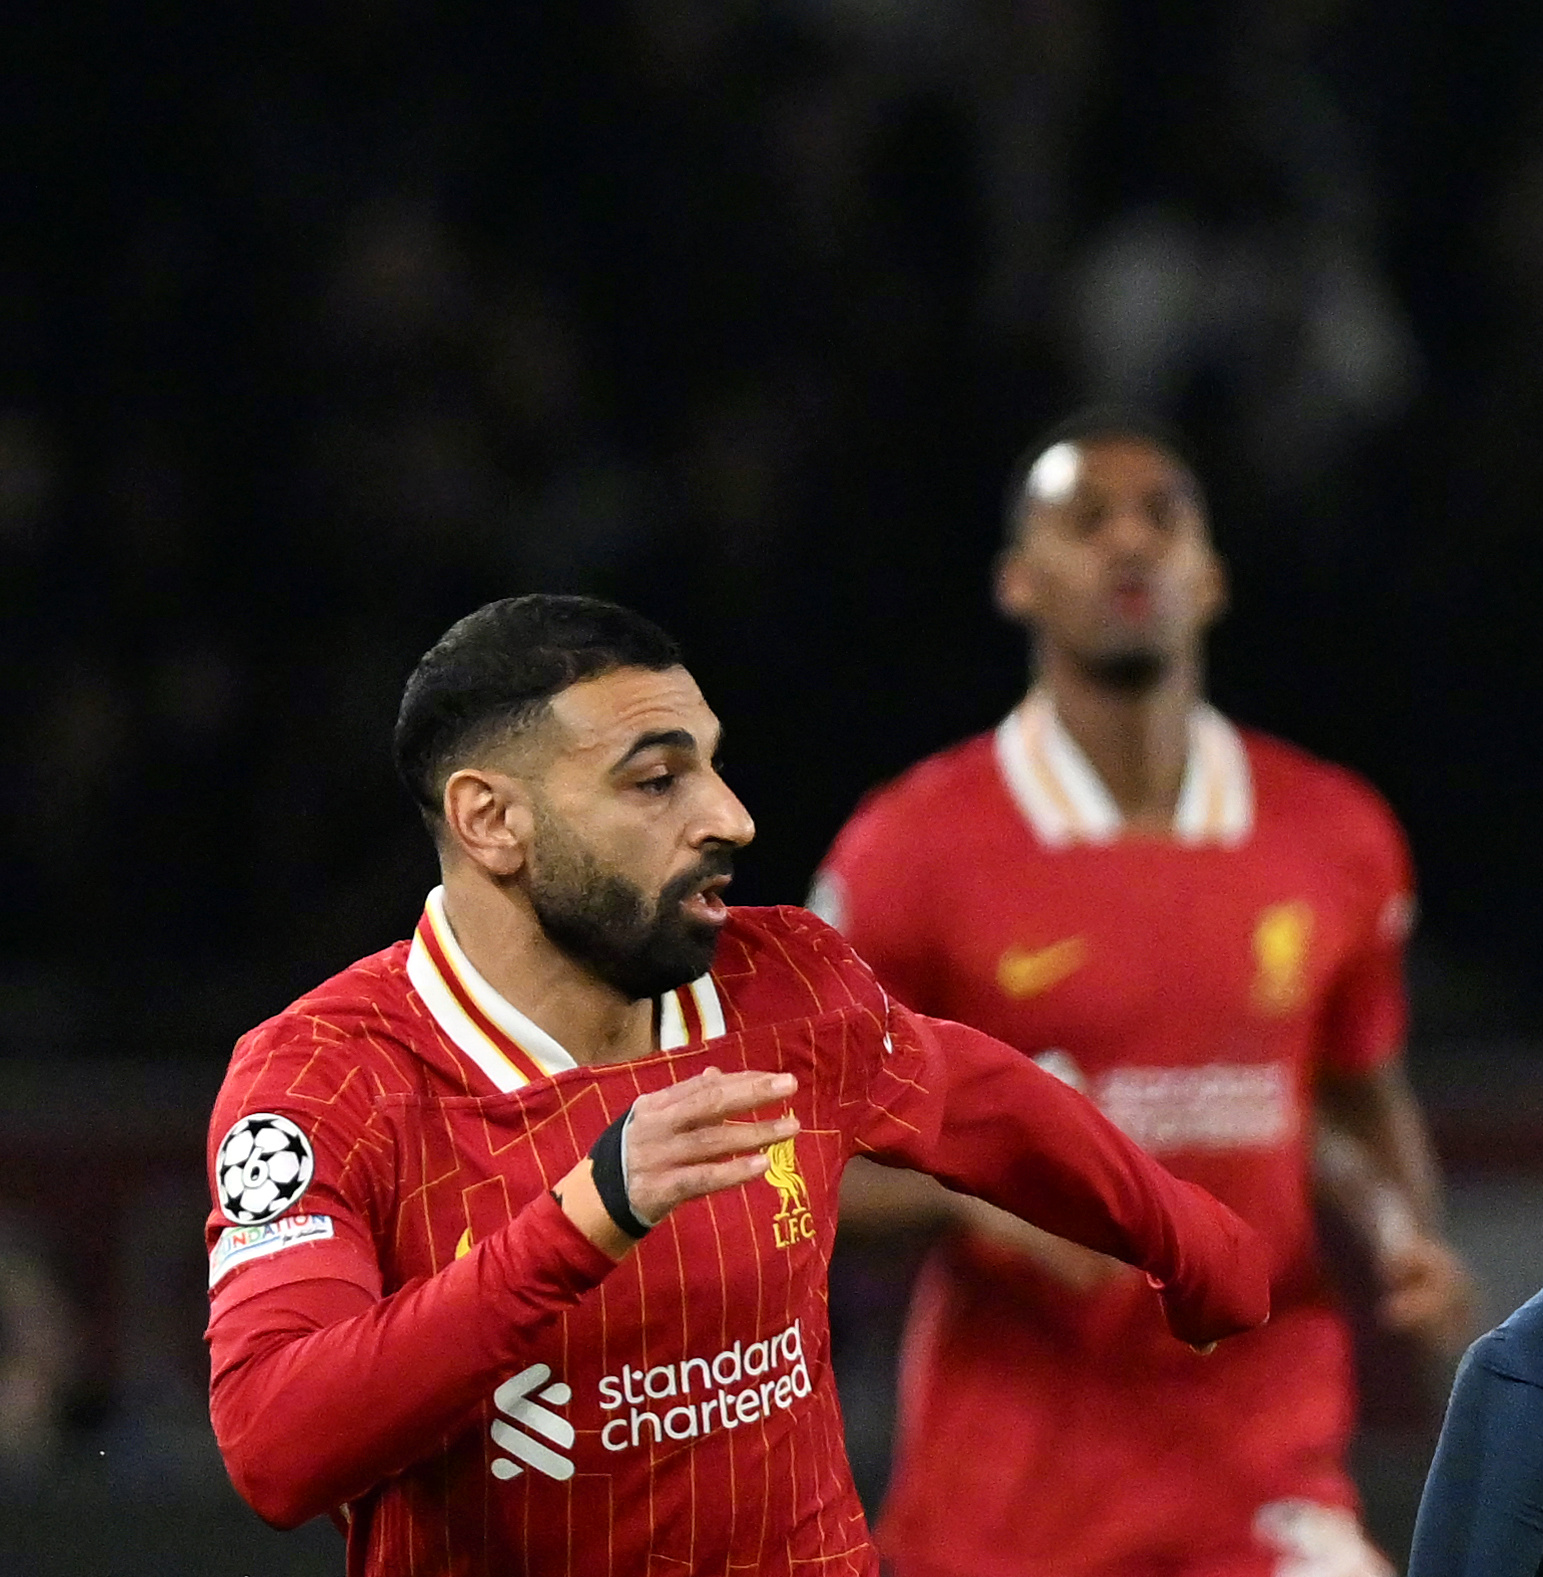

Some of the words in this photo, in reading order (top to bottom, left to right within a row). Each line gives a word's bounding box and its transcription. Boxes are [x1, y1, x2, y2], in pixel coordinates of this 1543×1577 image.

[242, 1146, 269, 1190] 6
[599, 1318, 803, 1410] standard
[601, 1356, 812, 1451] chartered
